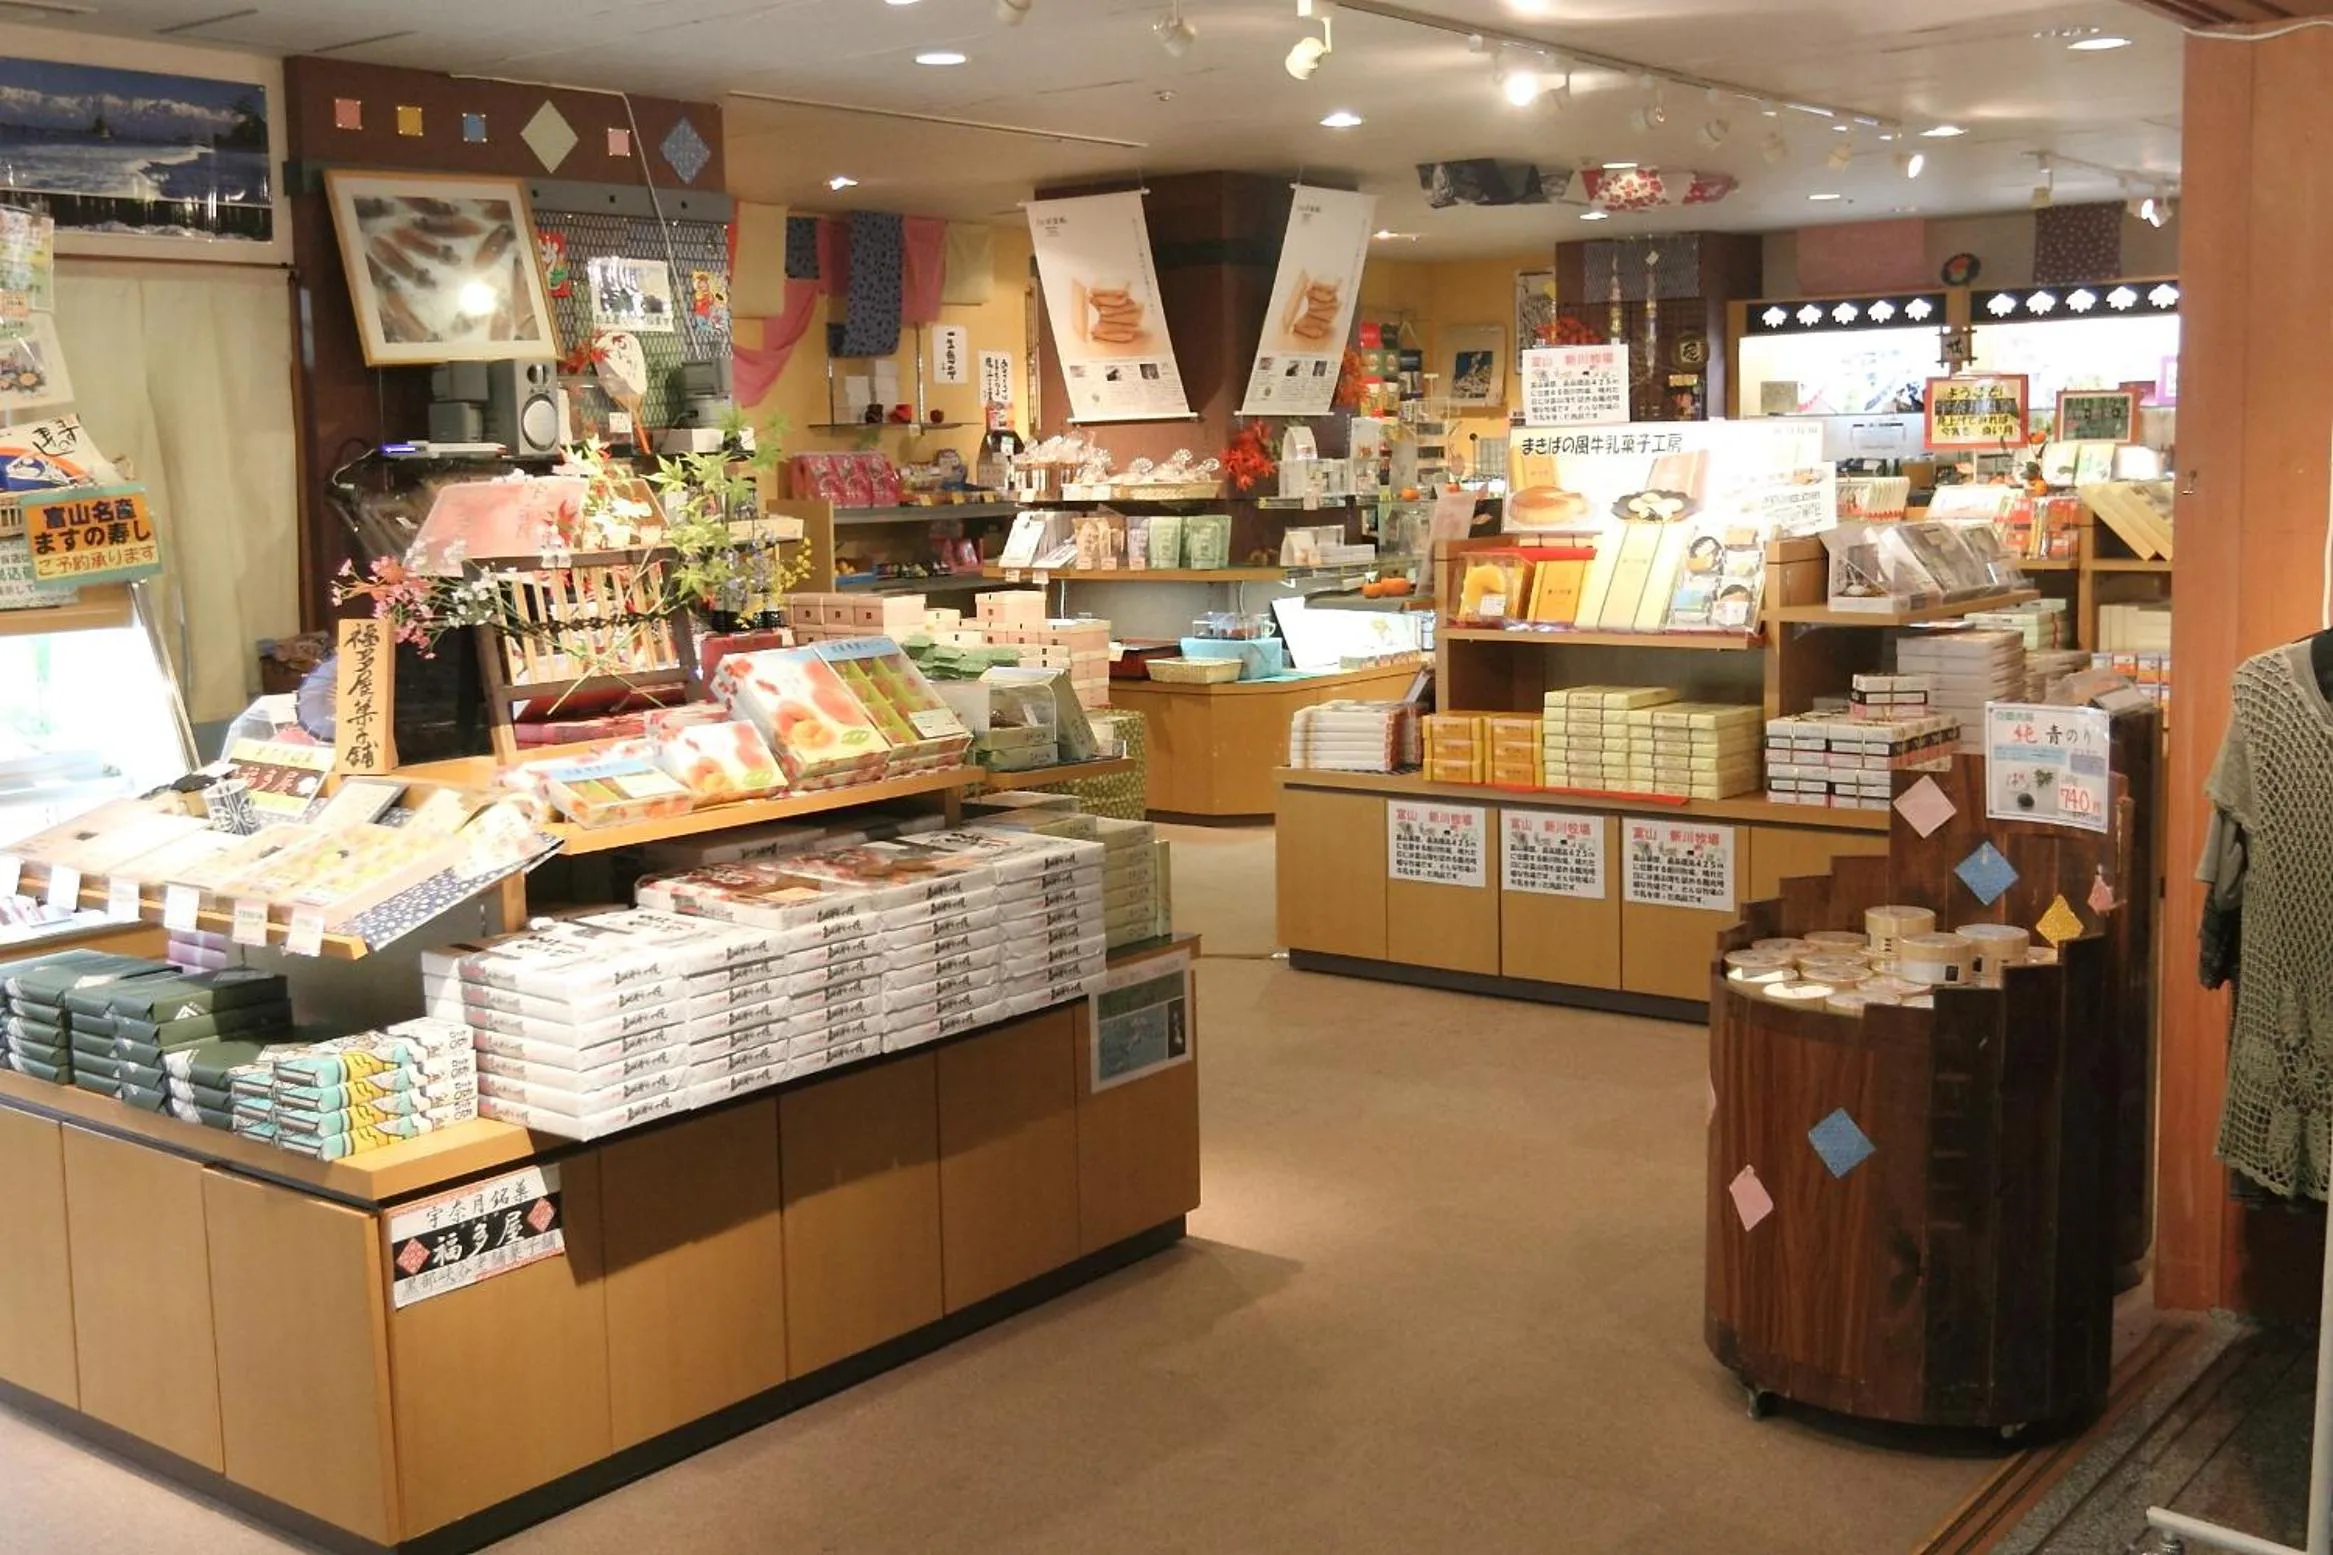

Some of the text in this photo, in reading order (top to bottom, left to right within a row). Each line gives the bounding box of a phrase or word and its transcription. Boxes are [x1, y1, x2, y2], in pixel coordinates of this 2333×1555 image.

[1521, 432, 1683, 455] まきばの風牛乳菓子工房
[43, 498, 137, 528] 富山名産
[34, 521, 151, 555] ますの寿し
[2045, 724, 2092, 745] 青のり
[1632, 826, 1656, 840] 富山
[426, 1178, 531, 1228] 宇奈月銘菓
[431, 1210, 525, 1267] 福多屋
